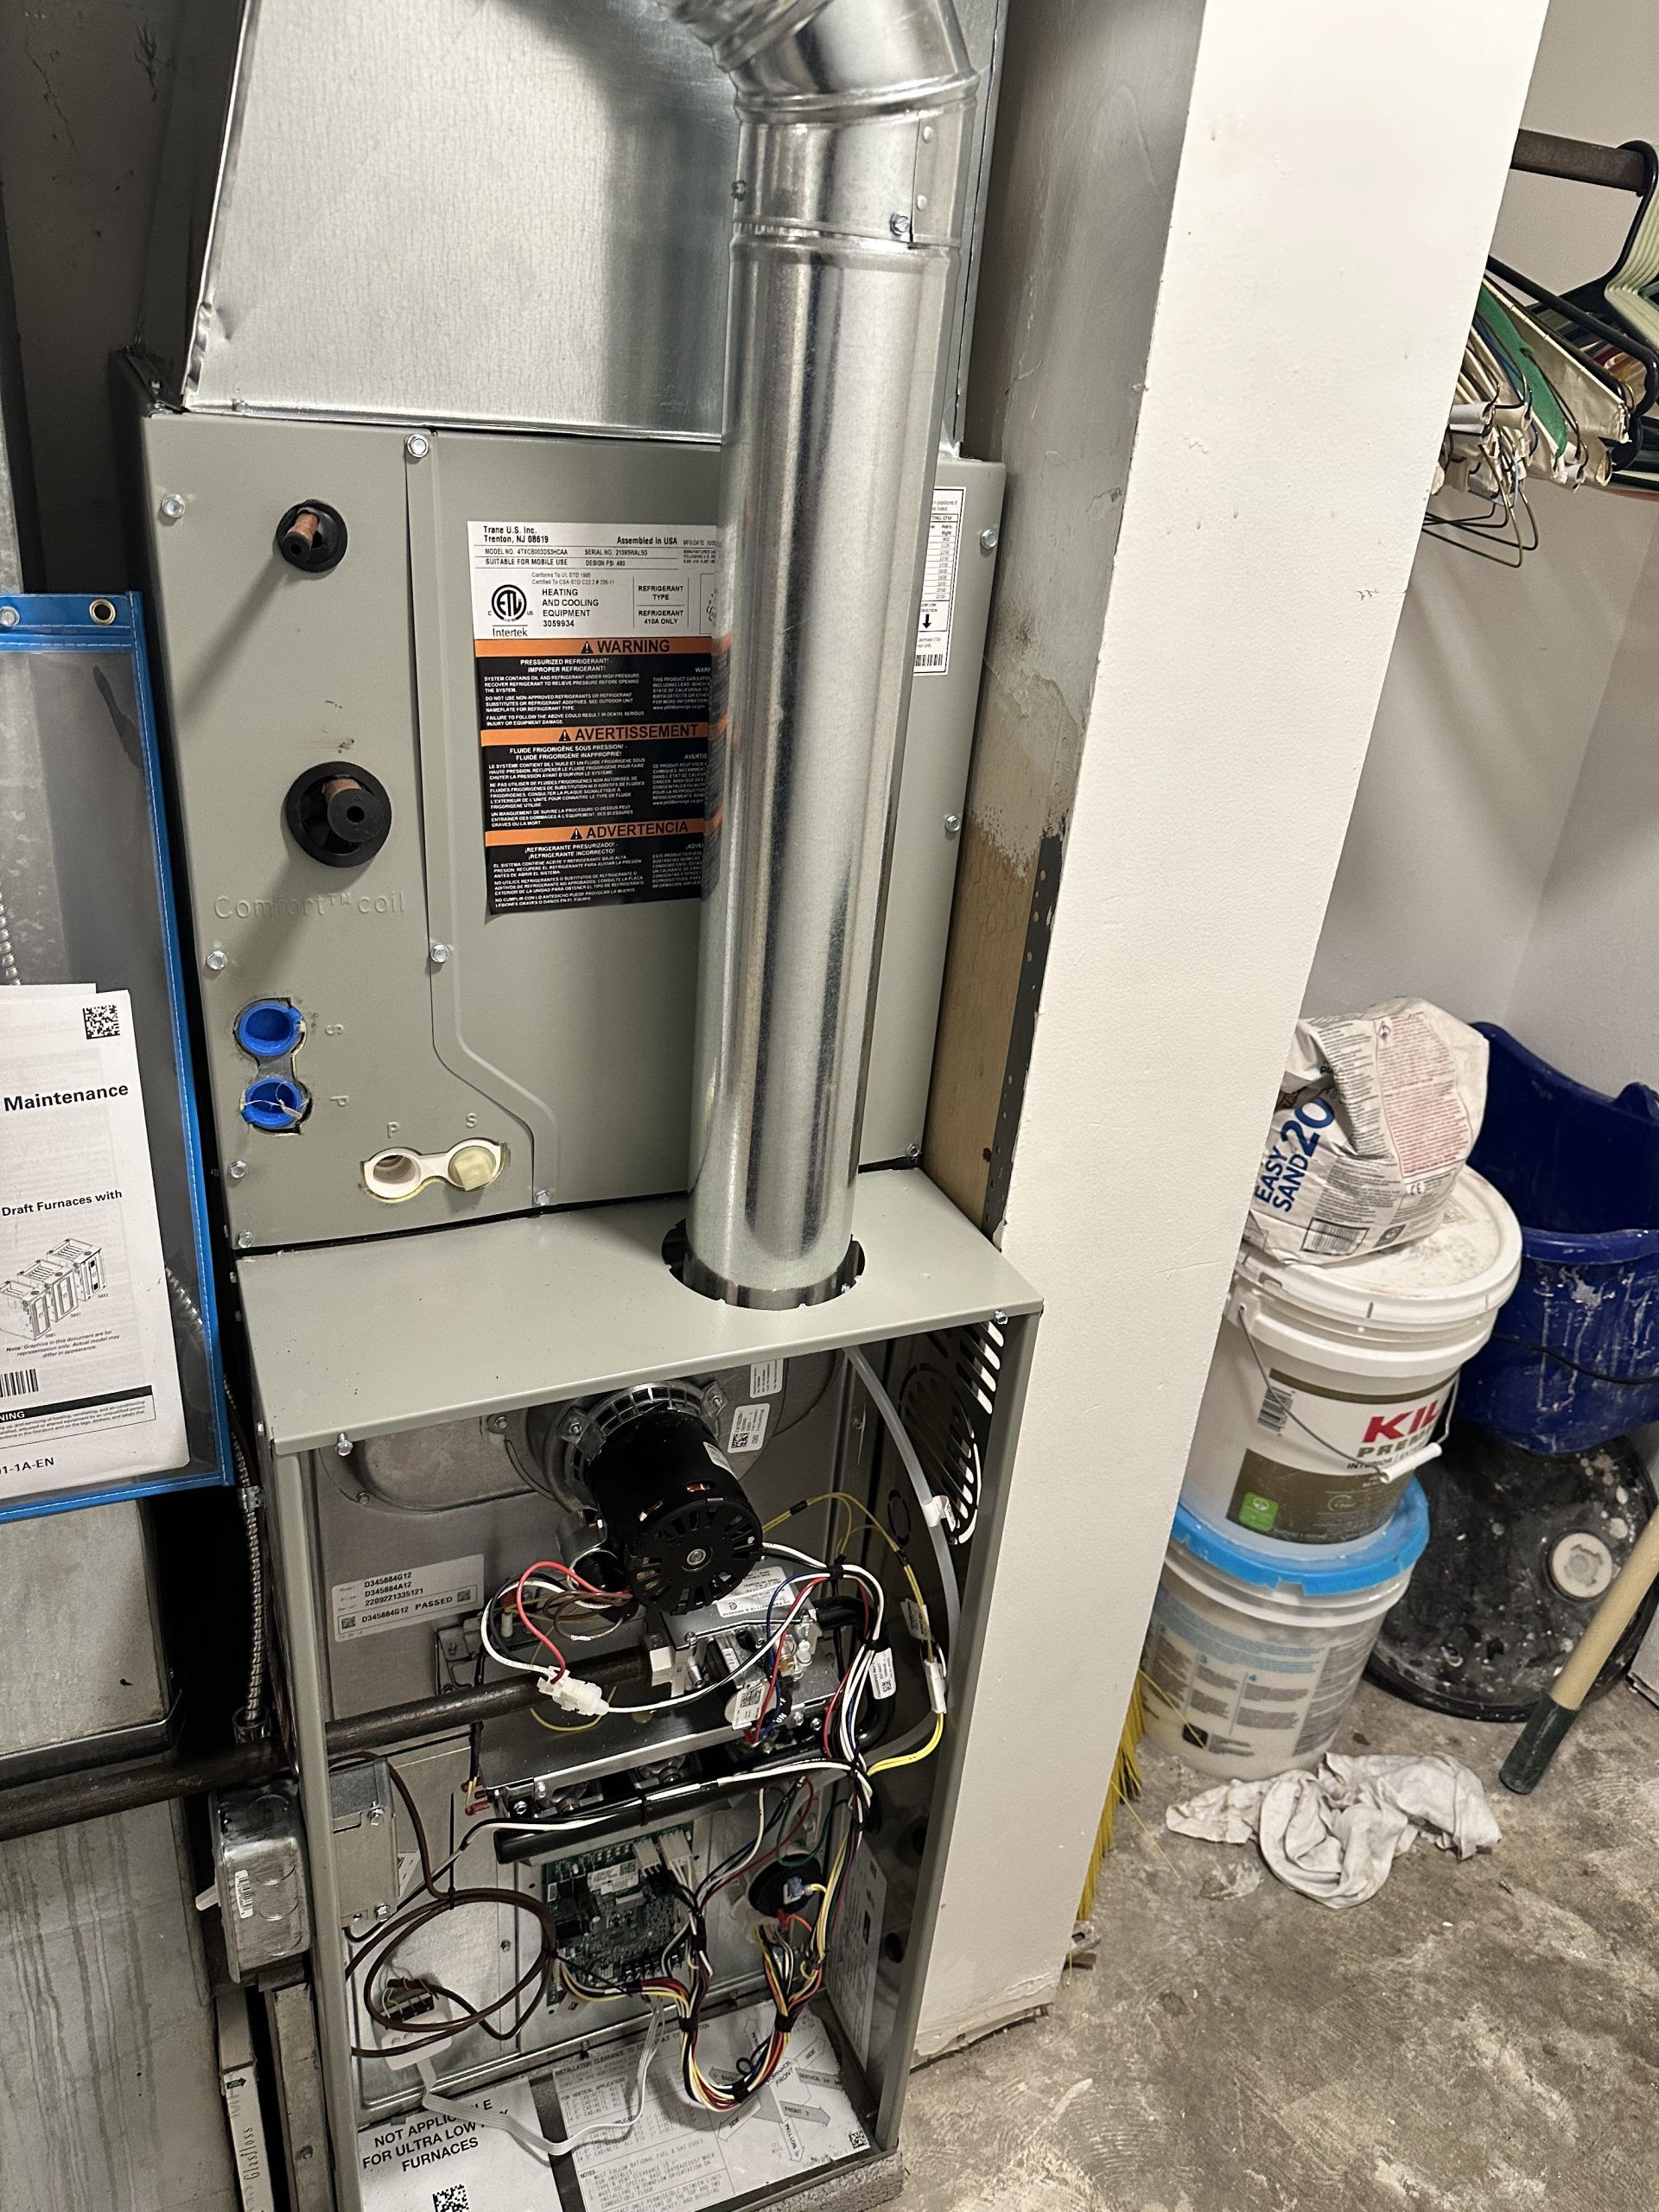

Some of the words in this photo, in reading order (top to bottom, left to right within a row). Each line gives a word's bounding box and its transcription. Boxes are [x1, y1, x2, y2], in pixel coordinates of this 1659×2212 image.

[493, 627, 527, 637] Intertek
[598, 639, 670, 653] WARNING
[575, 724, 698, 741] AVERTISSEMENT
[587, 822, 688, 839] ADVERTENCIA
[358, 891, 404, 914] coil
[4, 1084, 129, 1112] Maintenance
[466, 1113, 478, 1128] S
[1281, 1097, 1335, 1158] 20
[387, 1122, 400, 1138] P
[1254, 1146, 1283, 1204] EASY
[1273, 1153, 1309, 1212] SAND
[2, 1204, 34, 1217] Draft
[37, 1196, 92, 1211] Furnaces
[95, 1190, 122, 1202] with
[416, 1597, 453, 1611] PASSED
[594, 2051, 624, 2064] CLEARANCE
[776, 2067, 793, 2086] FRONT
[363, 2151, 391, 2169] FOR
[396, 2133, 442, 2157] ULTRA
[446, 2122, 475, 2141] LOW
[375, 2129, 404, 2147] NOT
[785, 2123, 798, 2150] BOTTOM
[402, 2138, 479, 2171] FURNACES
[580, 2170, 595, 2178] NOTES
